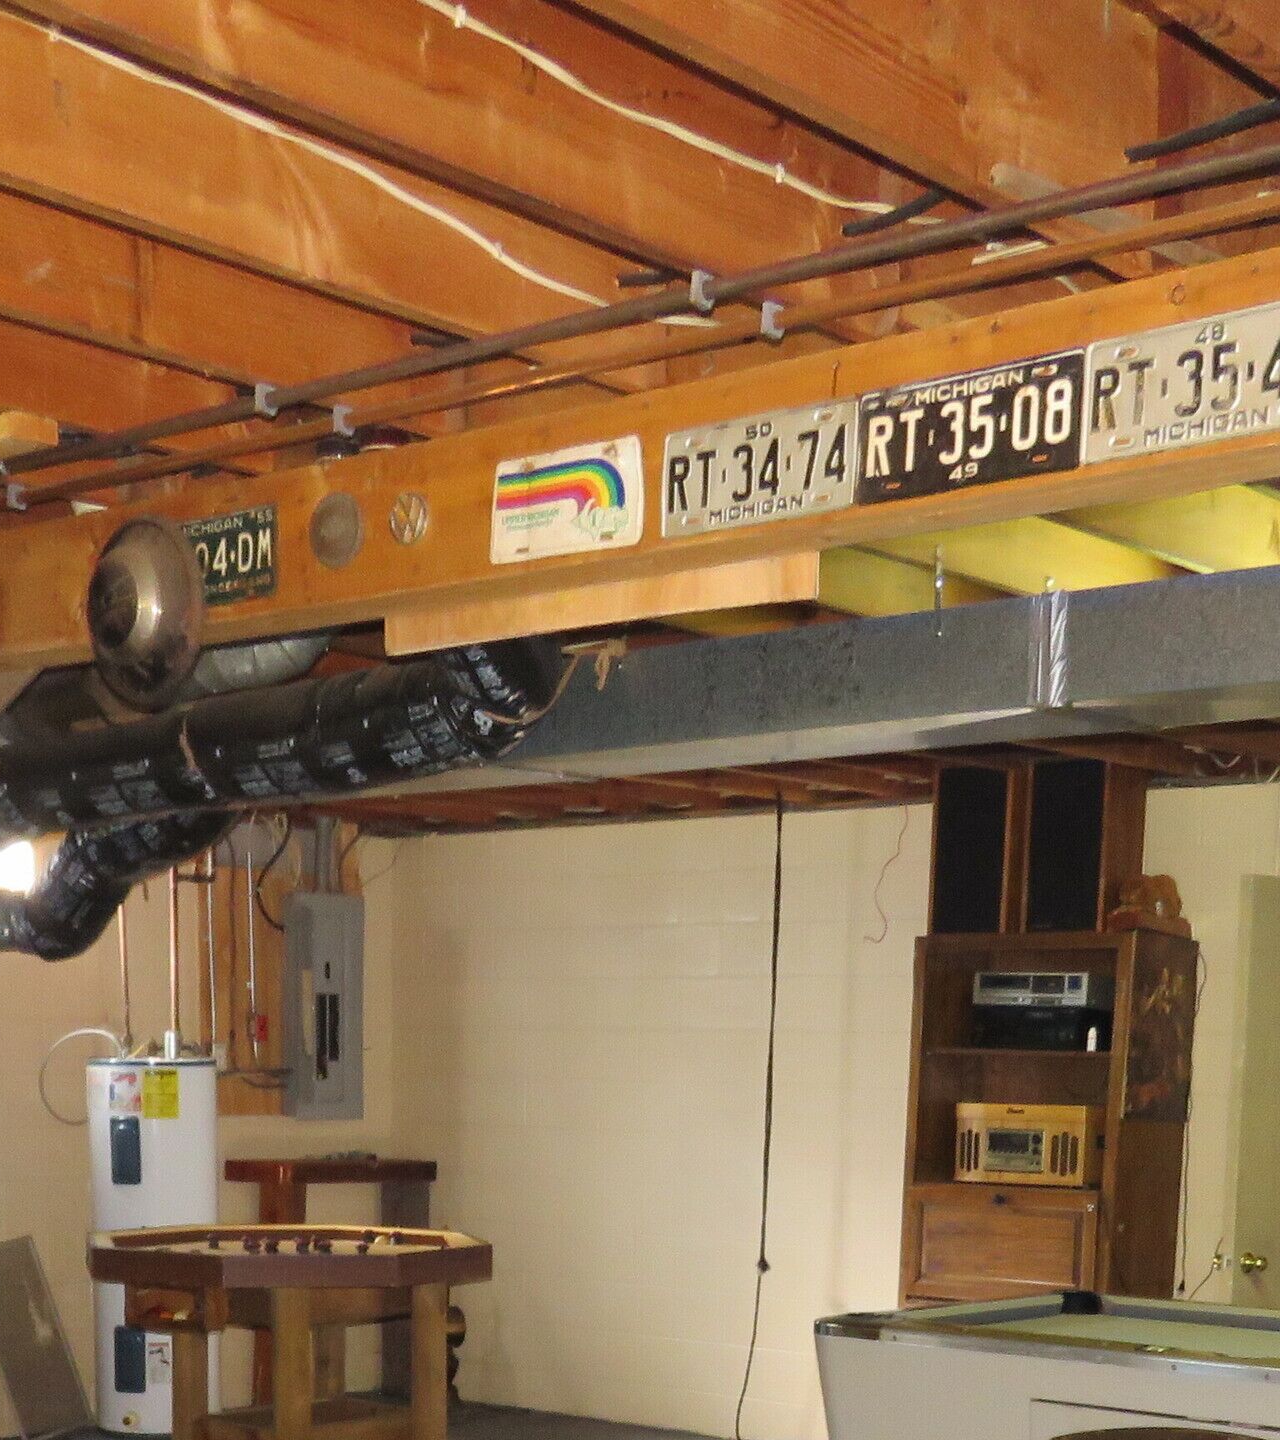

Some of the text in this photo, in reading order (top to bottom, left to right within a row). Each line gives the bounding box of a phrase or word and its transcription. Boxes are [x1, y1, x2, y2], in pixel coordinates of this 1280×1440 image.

[1195, 323, 1225, 344] 48
[915, 370, 1024, 406] MICHIGAN
[746, 421, 773, 441] 50
[1144, 407, 1270, 447] MICHIGAN
[948, 462, 979, 482] 49
[709, 495, 804, 525] MICHIGAN
